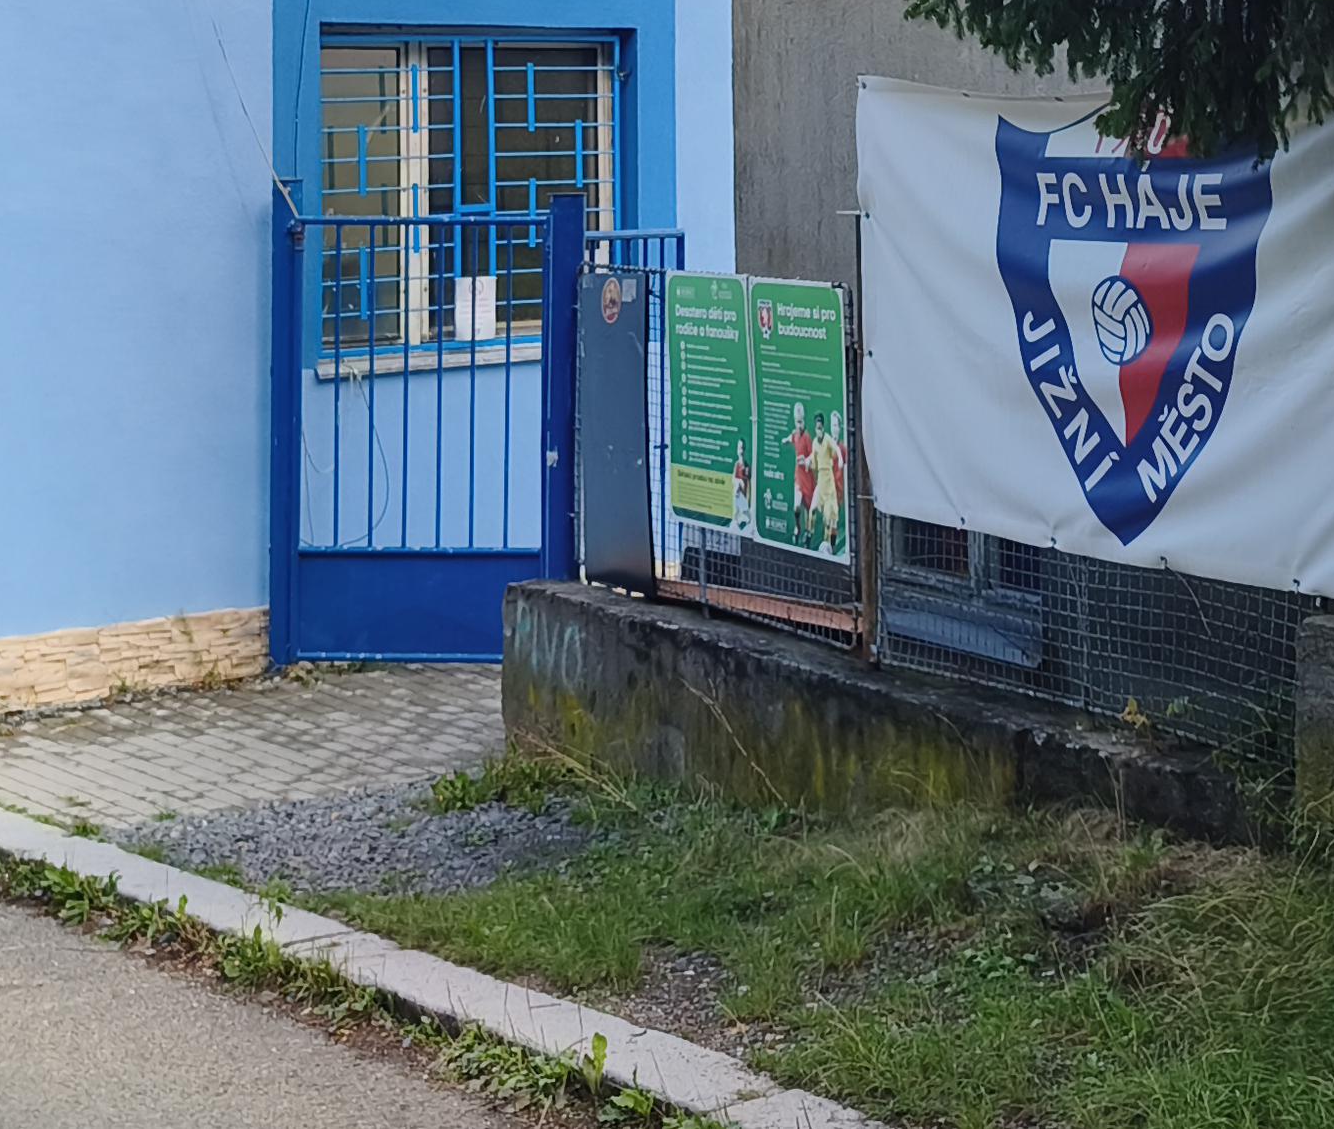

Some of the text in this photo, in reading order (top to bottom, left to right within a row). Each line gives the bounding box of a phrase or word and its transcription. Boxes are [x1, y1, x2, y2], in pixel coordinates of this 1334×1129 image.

[1036, 159, 1228, 231] FC HÁJE
[821, 309, 836, 322] pro
[1023, 311, 1120, 492] JIŽNÍ
[1136, 313, 1235, 503] MĚSTO
